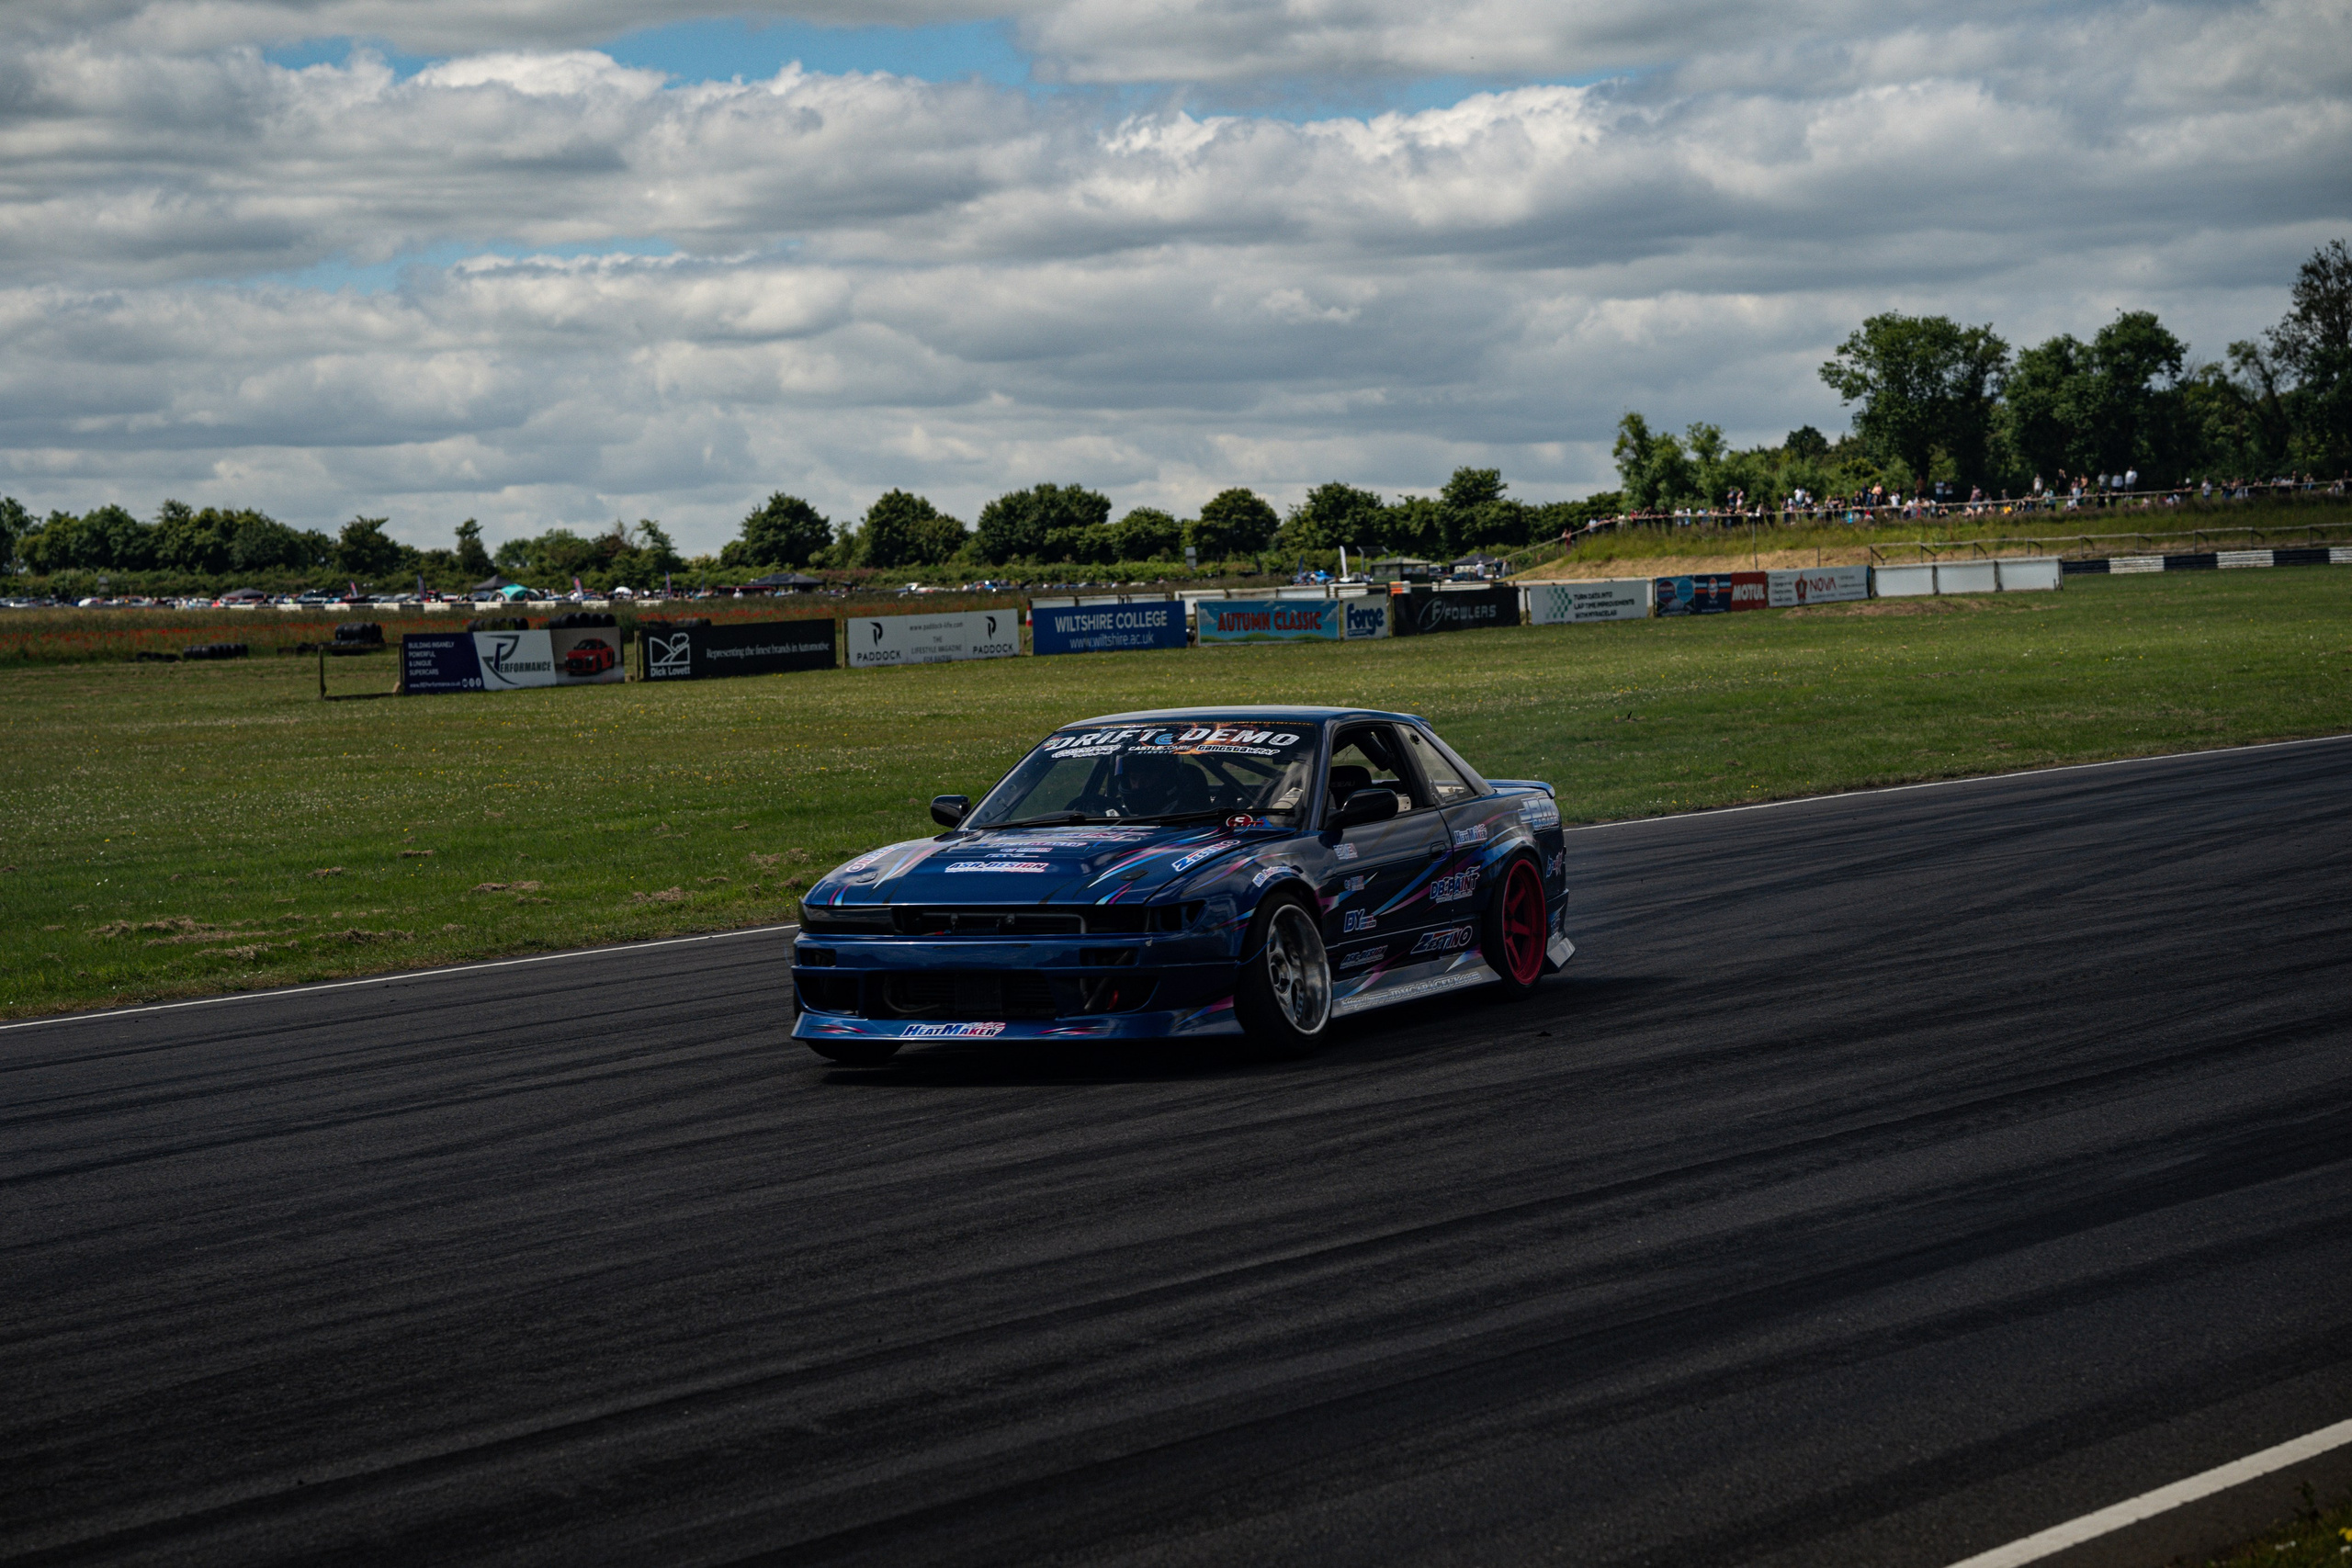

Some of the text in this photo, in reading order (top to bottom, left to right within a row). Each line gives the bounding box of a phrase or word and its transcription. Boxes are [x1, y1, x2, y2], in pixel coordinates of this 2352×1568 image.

[1732, 583, 1765, 602] MOTUL
[1809, 577, 1837, 592] NOVA
[1444, 604, 1497, 620] FOWLERS
[1055, 610, 1168, 633] WILTSHIRE COLLEGE
[1217, 612, 1322, 632] AUTUMN CLASSIC
[1069, 631, 1155, 649] www.wiltshire.ac.uk
[706, 647, 745, 660] Representing
[745, 645, 755, 656] the
[755, 645, 771, 655] finest
[772, 643, 791, 654] brands
[792, 643, 798, 653] in
[857, 650, 901, 661] PADDOCK
[973, 644, 1013, 654] PADDOCK
[650, 665, 691, 678] Dick Lovett
[1045, 728, 1167, 751] DRIFT
[1178, 728, 1300, 746] DEMO
[1410, 926, 1474, 955] ZESTINO
